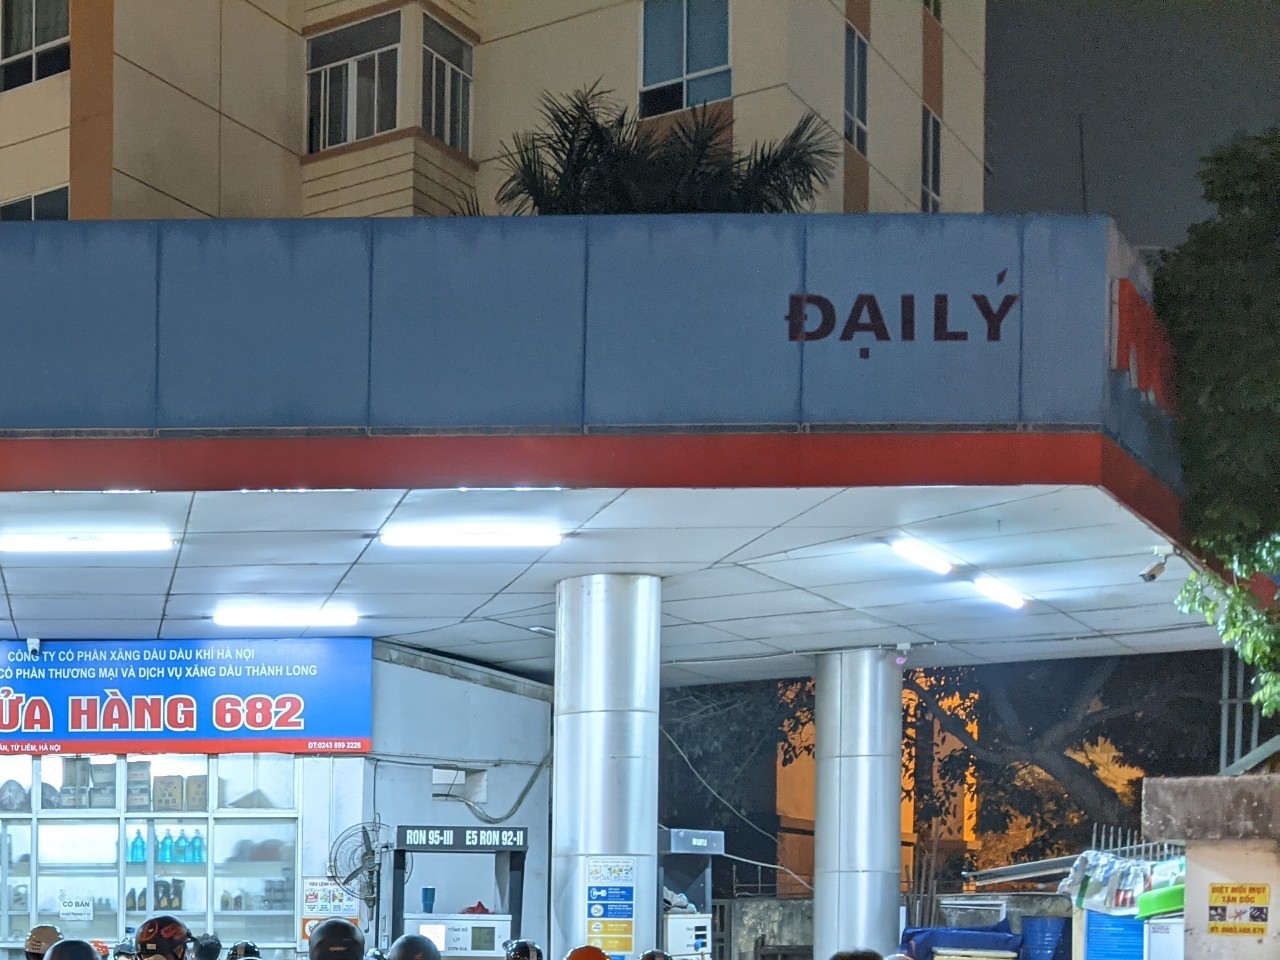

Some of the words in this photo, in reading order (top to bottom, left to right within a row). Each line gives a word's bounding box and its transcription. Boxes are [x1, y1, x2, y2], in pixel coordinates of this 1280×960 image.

[784, 293, 916, 359] ĐẠI
[933, 268, 1020, 342] LÝ
[42, 650, 56, 662] TY
[48, 666, 95, 679] THƯƠNG
[98, 667, 118, 680] MẠI
[120, 665, 136, 678] VÀ
[138, 666, 165, 679] DỊCH
[167, 666, 183, 680] VỤ
[286, 665, 317, 677] LONG
[68, 688, 197, 732] HÀNG
[213, 693, 305, 731] 682
[406, 830, 426, 845] RON
[428, 830, 453, 845] 95-III
[466, 830, 478, 845] E5
[480, 830, 500, 845] RON
[502, 830, 523, 846] 92-II
